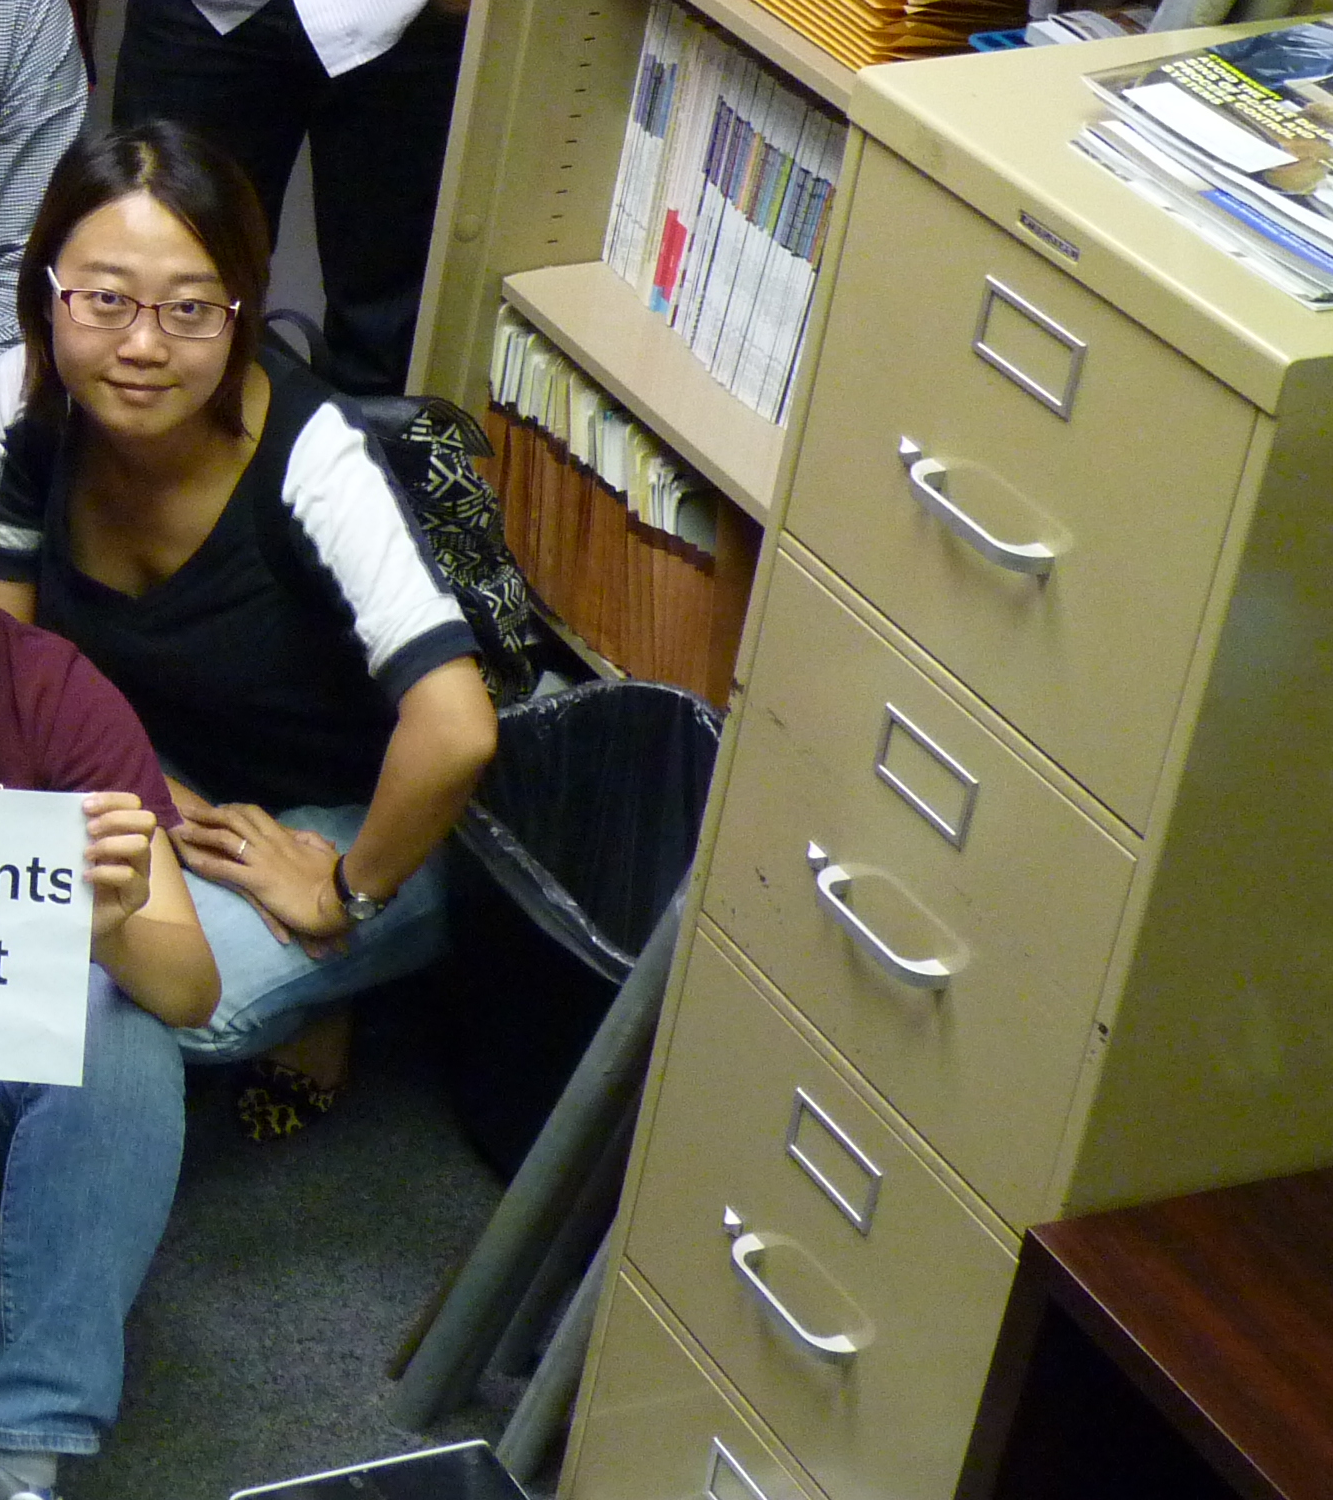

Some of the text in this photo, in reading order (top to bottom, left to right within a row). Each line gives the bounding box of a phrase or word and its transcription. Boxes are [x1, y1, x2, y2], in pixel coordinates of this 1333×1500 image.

[1160, 63, 1225, 106] SYSTEMS
[1172, 60, 1297, 140] PROCESS CONTROL
[1185, 58, 1221, 81] SINS
[1236, 93, 1284, 122] SCADA
[1282, 121, 1317, 139] AND
[1196, 56, 1240, 84] AVOID
[1237, 82, 1267, 100] THE
[1263, 98, 1299, 118] FIVE
